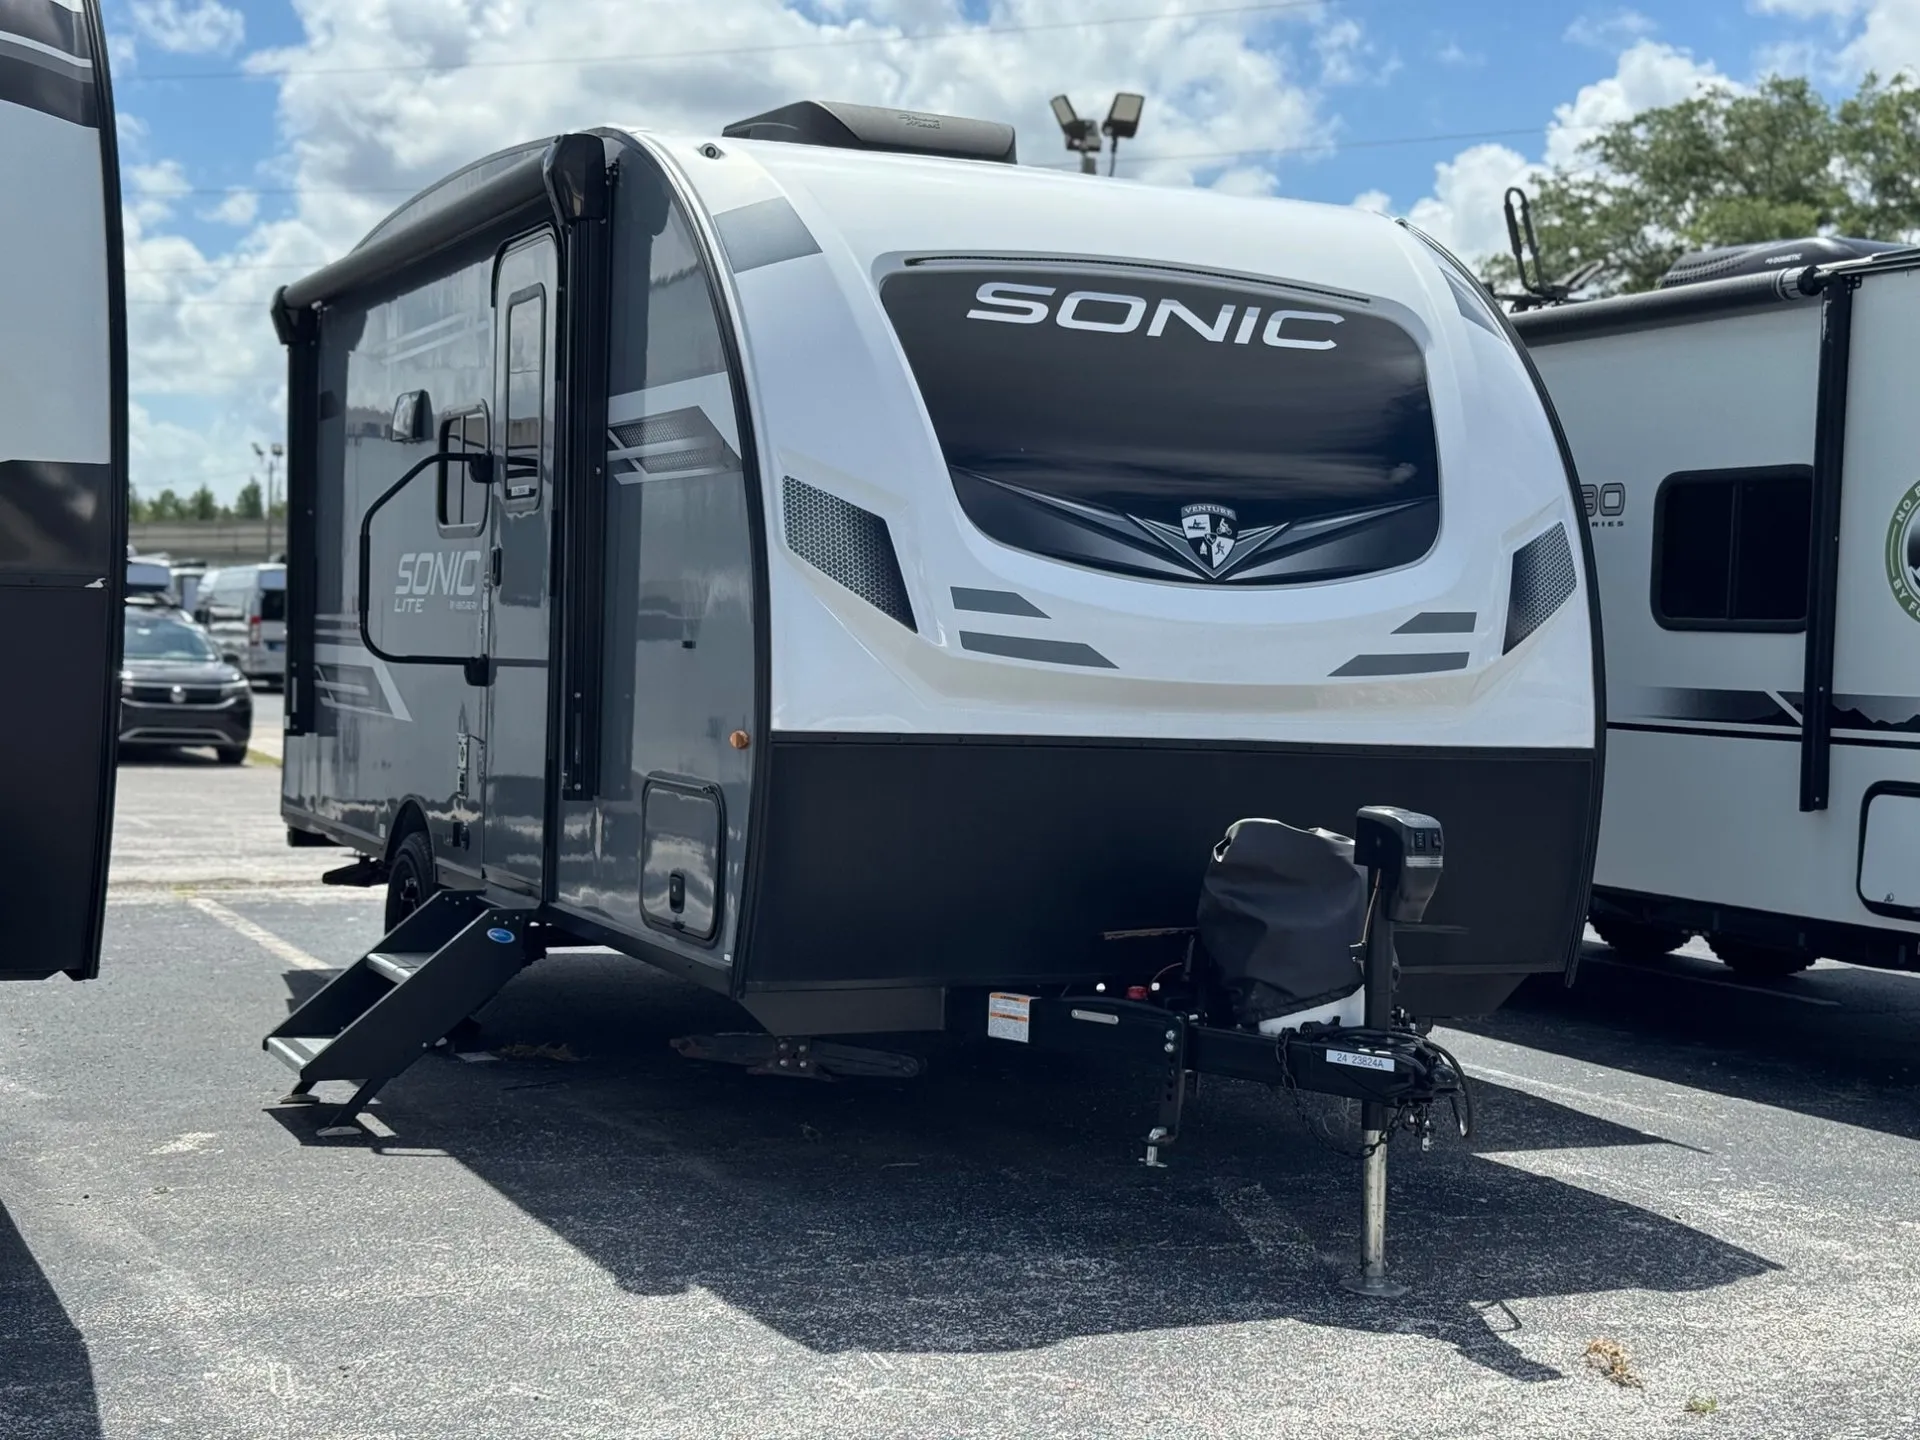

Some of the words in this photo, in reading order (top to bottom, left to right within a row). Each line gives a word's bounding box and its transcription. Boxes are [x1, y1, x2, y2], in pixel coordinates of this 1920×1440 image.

[966, 282, 1346, 350] SONIC
[1184, 504, 1234, 517] VENTURE
[1896, 499, 1911, 522] NO
[1591, 520, 1624, 528] RIES
[395, 550, 481, 596] SONIC
[1893, 578, 1908, 598] BY
[393, 598, 425, 613] LITE
